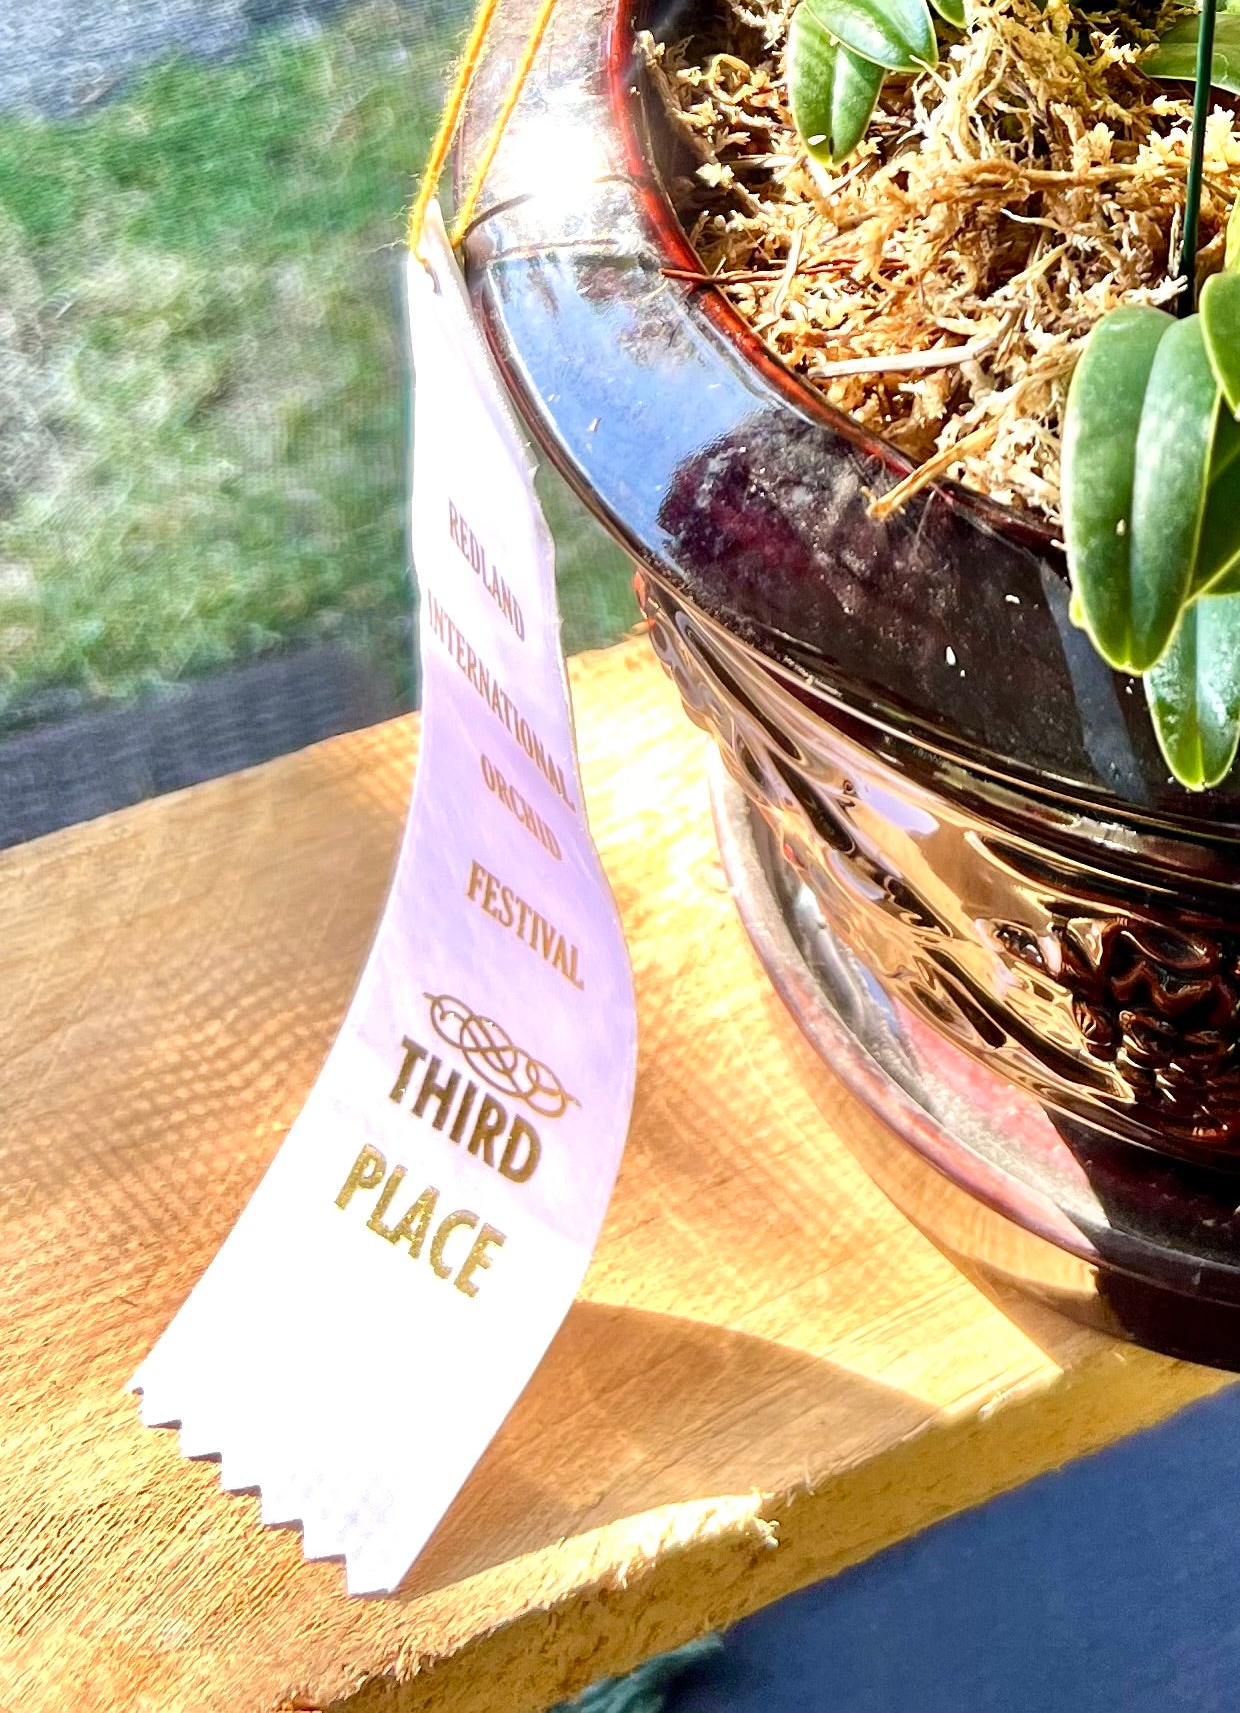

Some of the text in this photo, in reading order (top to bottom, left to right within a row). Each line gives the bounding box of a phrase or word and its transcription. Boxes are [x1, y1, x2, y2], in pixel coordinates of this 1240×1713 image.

[448, 497, 525, 641] REDLAND
[428, 590, 576, 813] INTERNATIONAL
[481, 752, 562, 860] ORCHID
[467, 858, 585, 990] FESTIVAL
[390, 1036, 542, 1183] THIRD
[335, 1144, 506, 1297] PLACE
